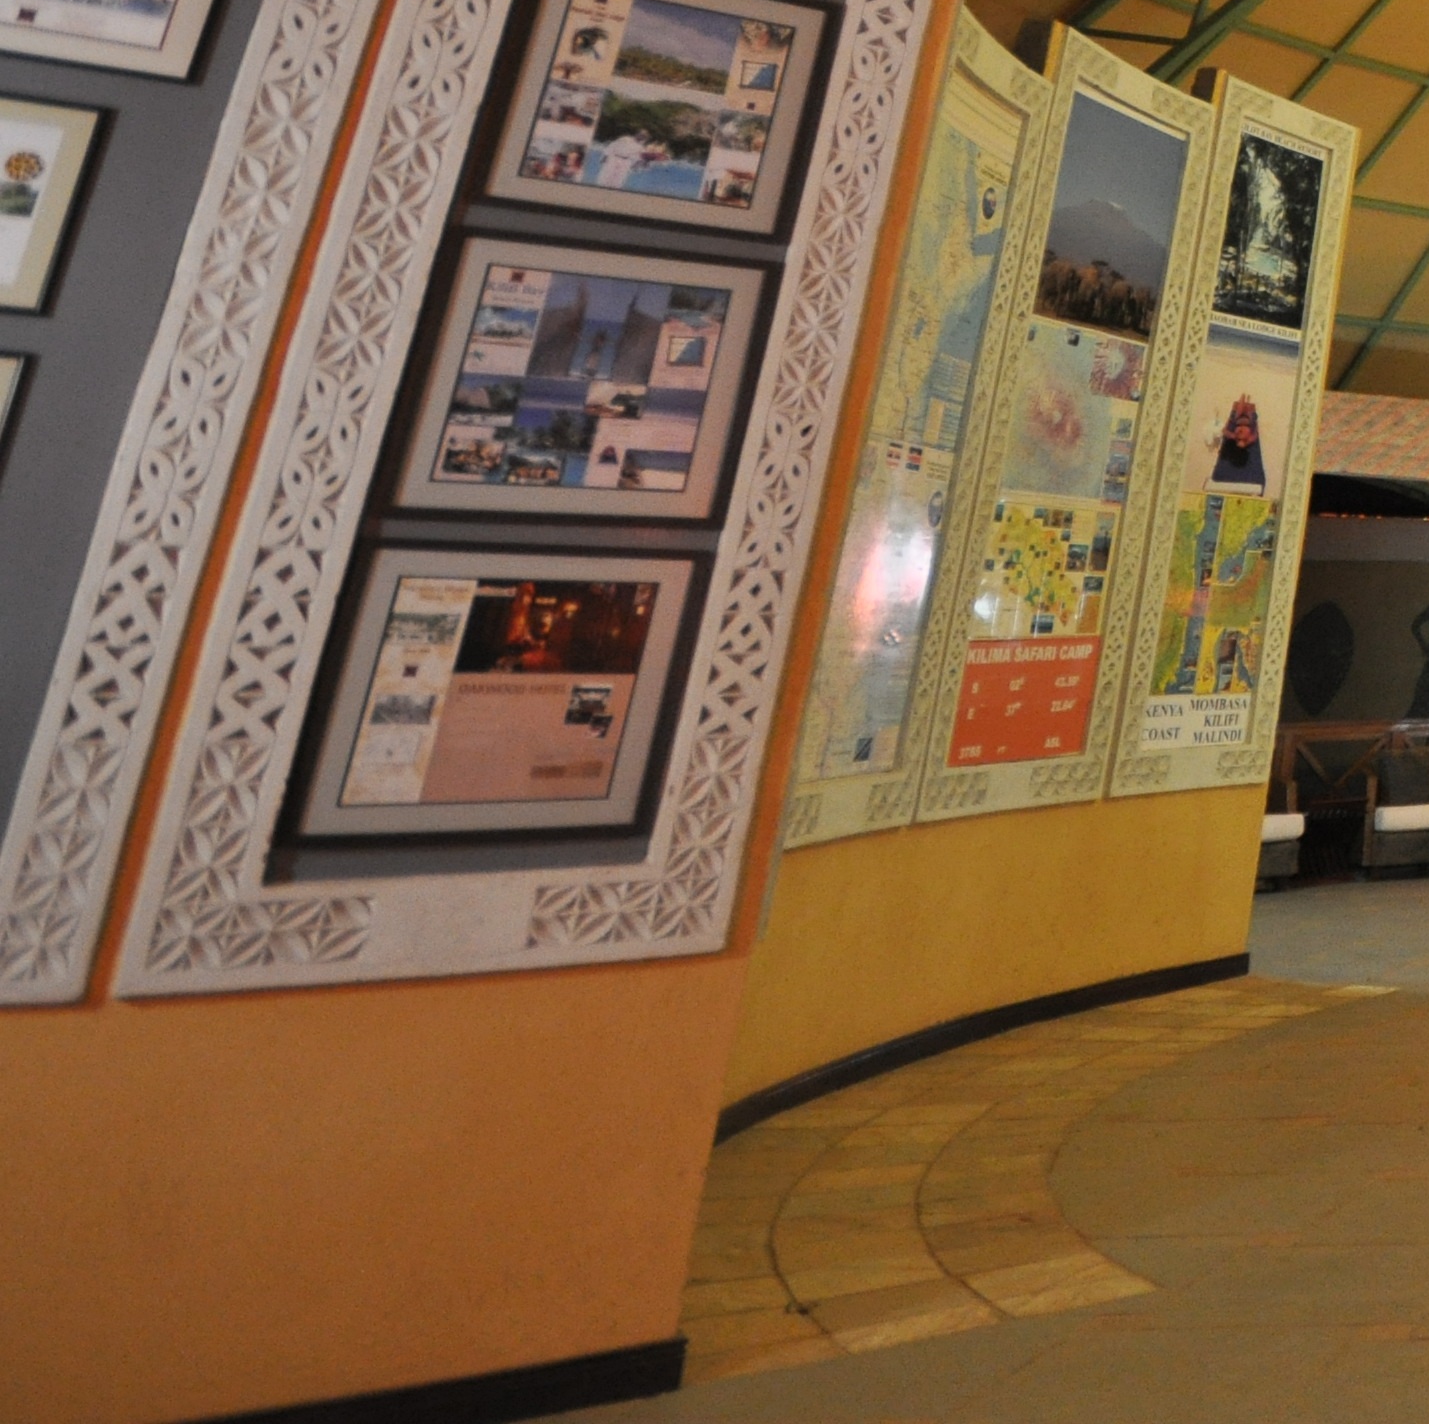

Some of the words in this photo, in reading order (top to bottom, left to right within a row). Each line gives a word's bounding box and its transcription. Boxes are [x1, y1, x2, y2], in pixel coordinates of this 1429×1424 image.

[966, 647, 1010, 665] KILIMA
[1013, 645, 1056, 663] SAFARI
[1059, 643, 1093, 660] CAMP
[1189, 697, 1248, 712] MOMBASA
[1203, 713, 1240, 728] KILIFI
[1192, 728, 1243, 745] MALINDI
